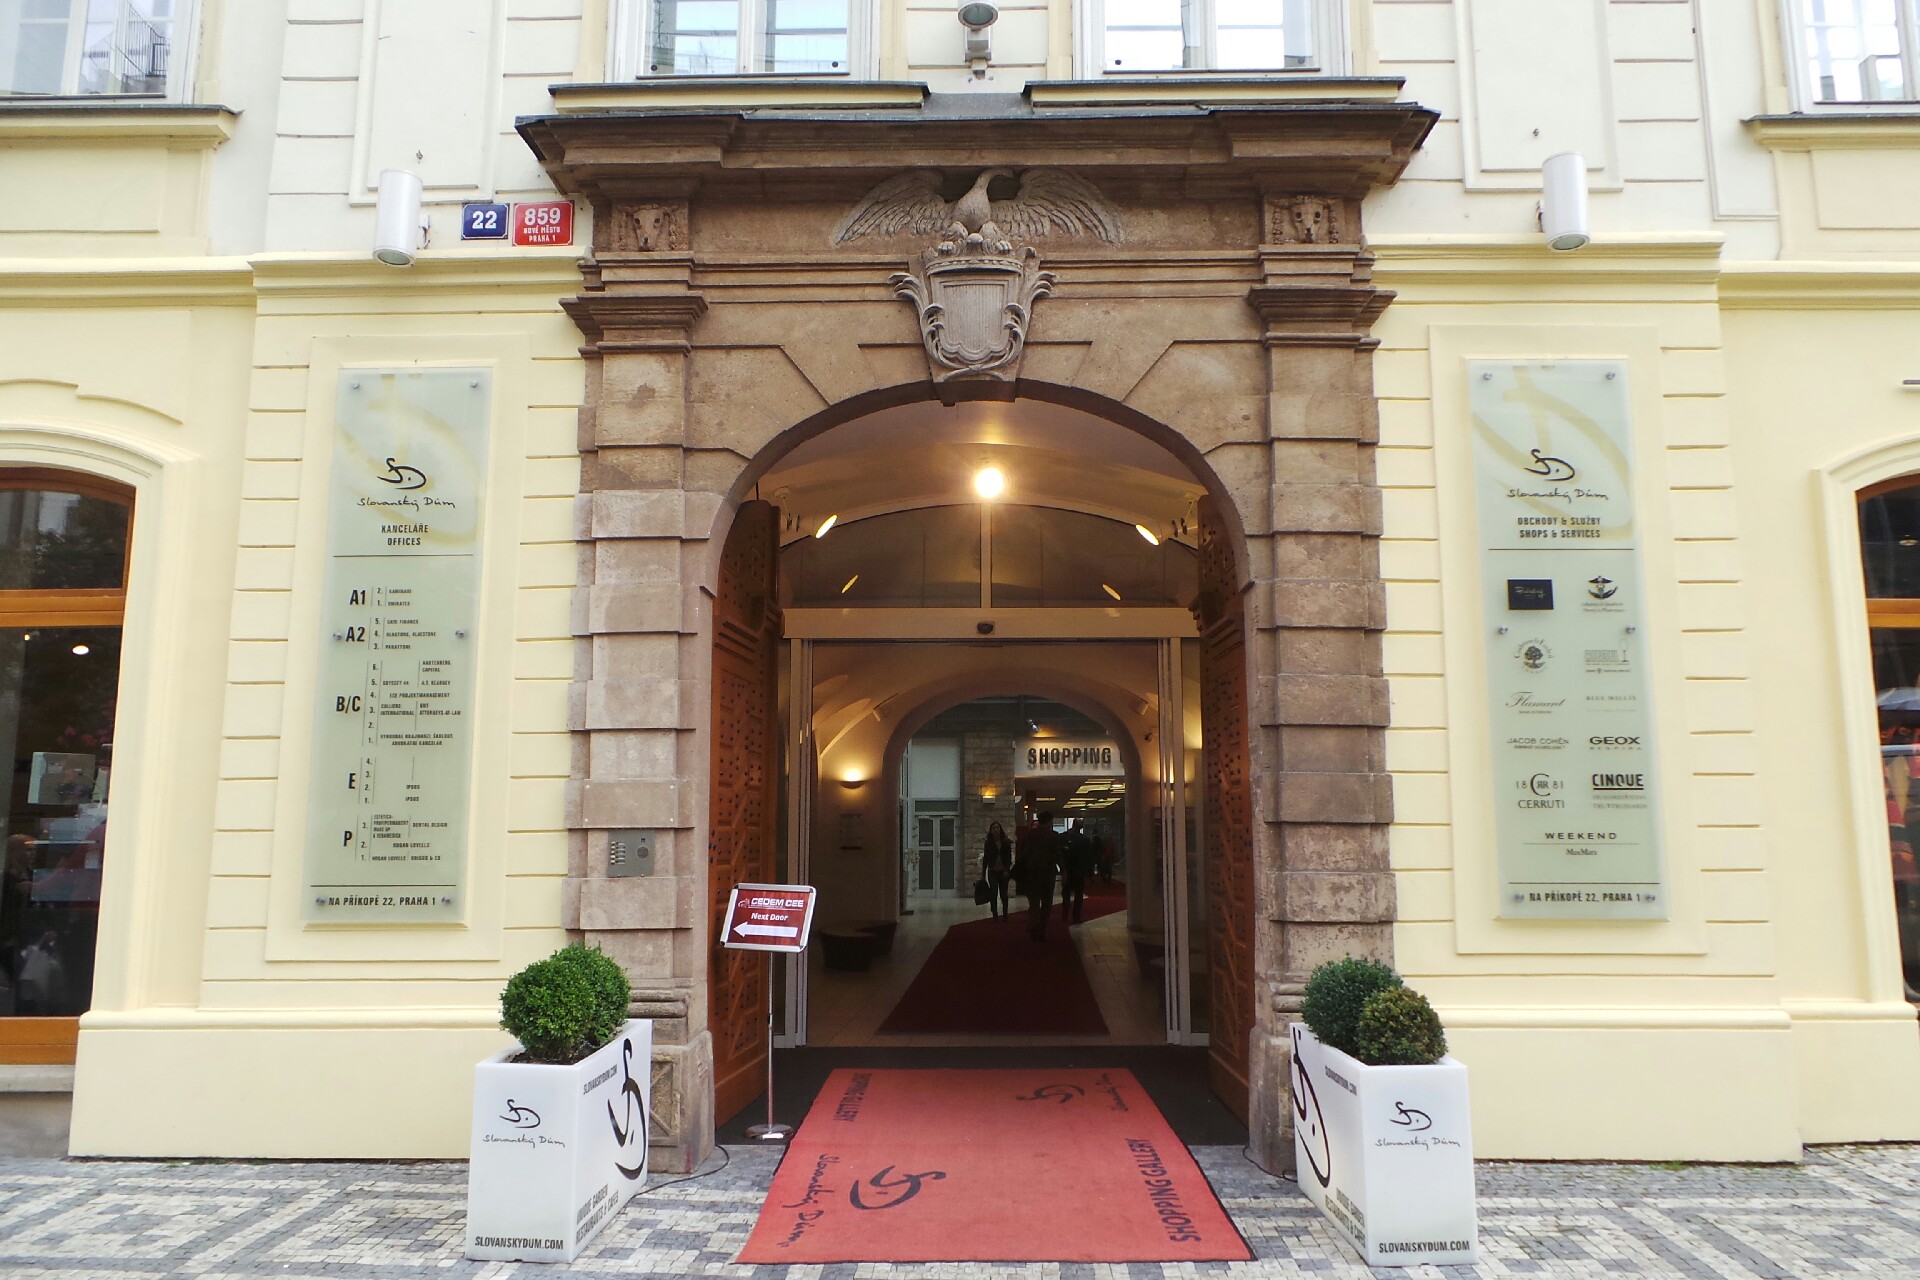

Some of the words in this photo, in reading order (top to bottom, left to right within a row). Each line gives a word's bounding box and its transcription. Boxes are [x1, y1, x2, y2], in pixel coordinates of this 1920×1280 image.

[472, 211, 497, 229] 22
[524, 208, 561, 226] 859
[524, 225, 538, 234] NOVÉ
[541, 225, 560, 233] MĚSTO
[1518, 517, 1557, 525] OBCHODY
[1561, 517, 1567, 525] &
[1570, 514, 1600, 525] SLUŽBY
[381, 523, 429, 534] KANCELÁŘE
[1520, 530, 1548, 538] SHOPS
[1552, 530, 1557, 538] &
[1561, 530, 1600, 538] SERVICES
[387, 537, 421, 546] OFFICES
[349, 589, 366, 605] A1
[345, 626, 365, 642] A2
[336, 696, 361, 714] B/C
[1589, 737, 1641, 745] GEOX
[1027, 747, 1111, 765] SHOPPING
[348, 772, 356, 789] E
[1592, 774, 1644, 788] CINQUE
[1518, 800, 1565, 809] CERRUTI
[343, 831, 352, 847] P
[1545, 832, 1617, 840] WEEKEND
[328, 896, 340, 906] NA
[343, 894, 379, 906] PŘÍKOPĚ
[383, 896, 396, 907] 22,
[399, 896, 428, 906] PRAHA
[430, 897, 435, 905] 1
[1530, 893, 1541, 901] NA
[1545, 890, 1582, 901] PŘÍKOPĚ
[1586, 894, 1599, 902] 22,
[1603, 892, 1636, 901] PRAHA
[751, 898, 785, 908] CEDEM
[785, 899, 804, 908] CEE
[751, 912, 769, 921] Next
[769, 913, 788, 921] Door
[1125, 1138, 1167, 1178] GALLERY
[1145, 1179, 1201, 1242] SHOPPING
[475, 1236, 564, 1250] SLOVANSKYDUM.COM
[1379, 1240, 1470, 1253] SLOVANSKYDUM.COM
